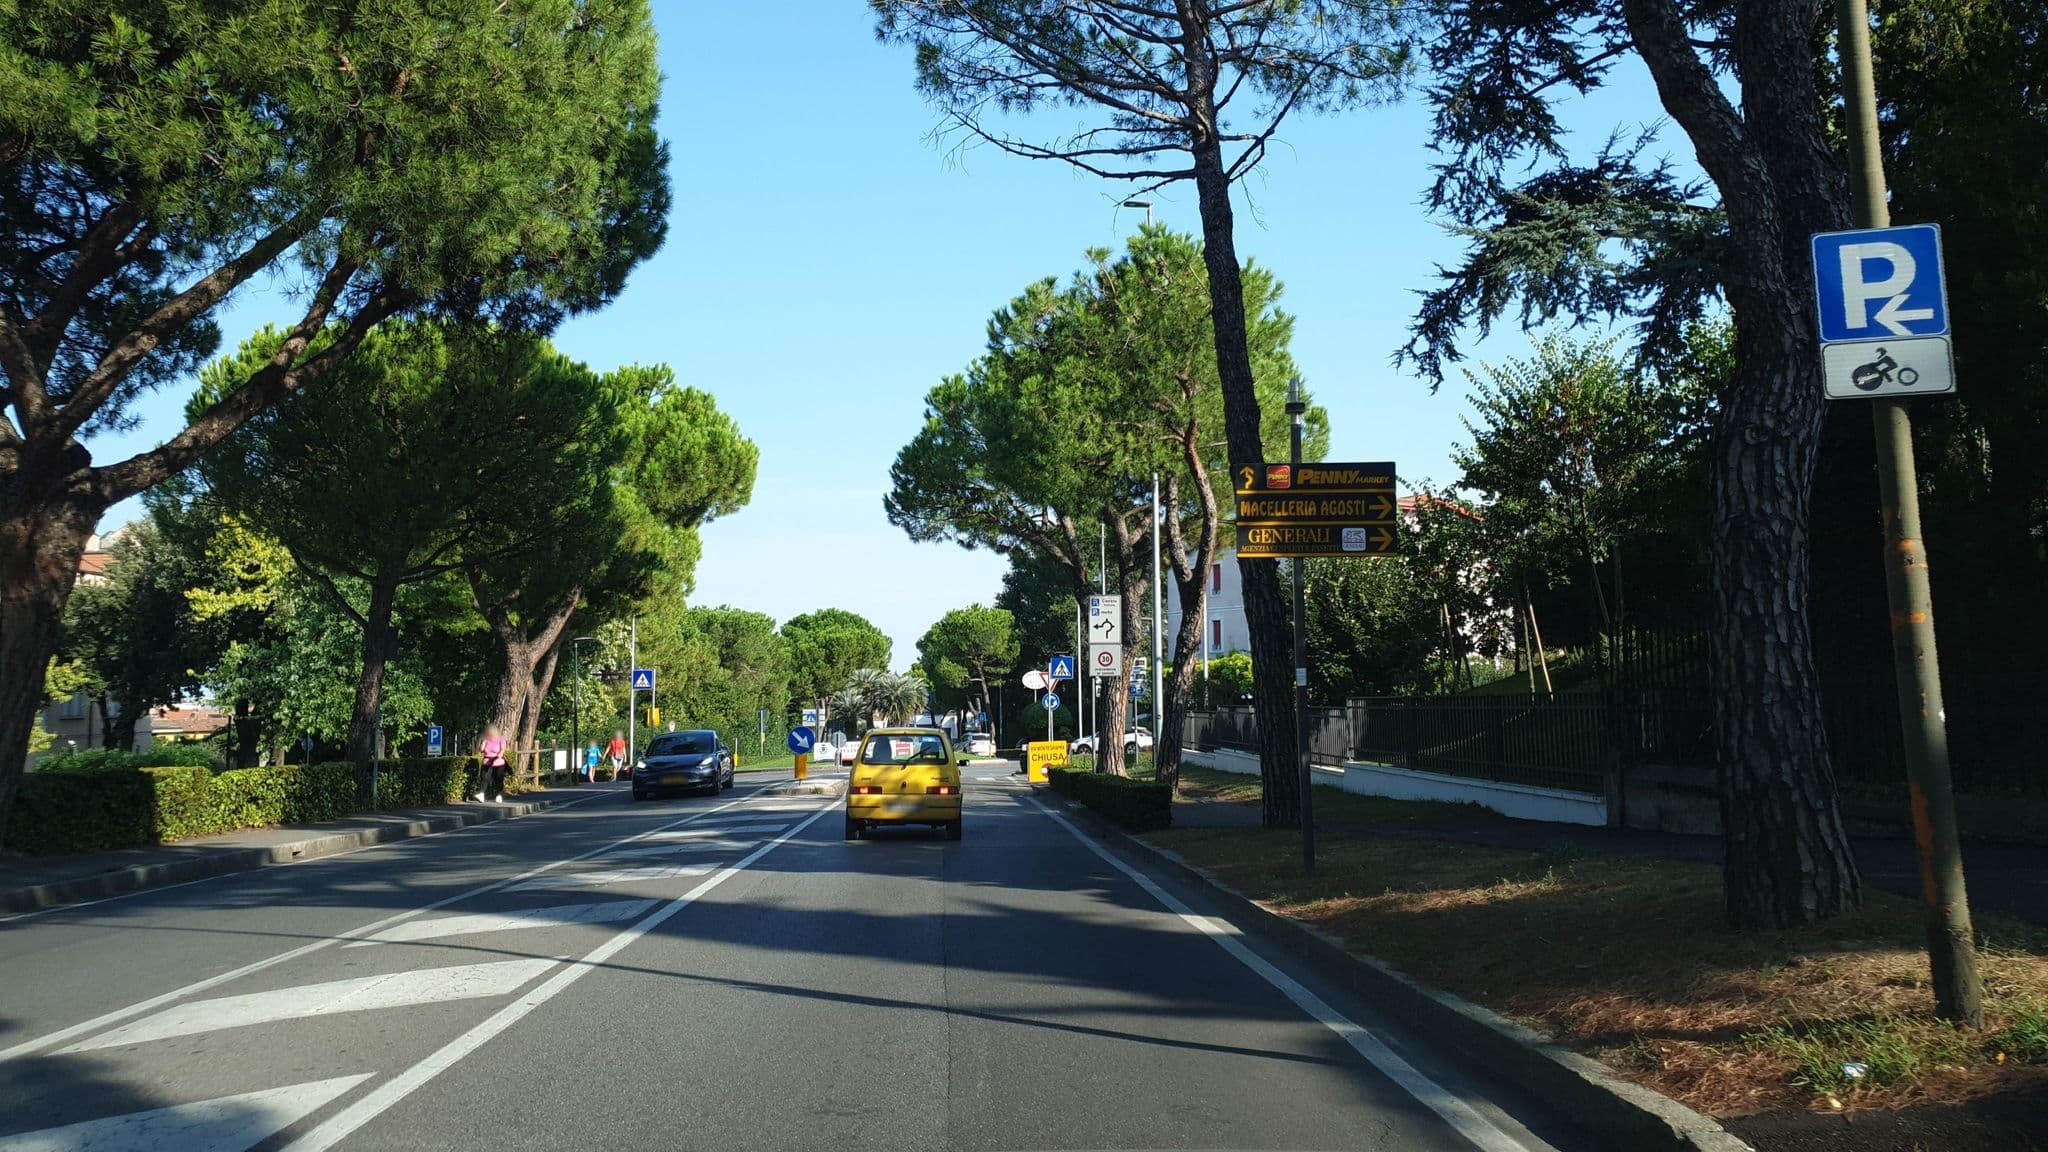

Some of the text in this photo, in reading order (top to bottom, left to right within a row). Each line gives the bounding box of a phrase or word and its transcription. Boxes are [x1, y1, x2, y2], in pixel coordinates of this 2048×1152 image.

[1839, 242, 1916, 329] P
[1297, 468, 1390, 484] PENNY MARKET
[1241, 500, 1365, 516] MACELLERIA AGOSTI
[1248, 528, 1330, 544] GENERALI
[1241, 545, 1271, 553] AGENZIA
[430, 729, 439, 743] P
[1032, 753, 1063, 761] CHIUSA
